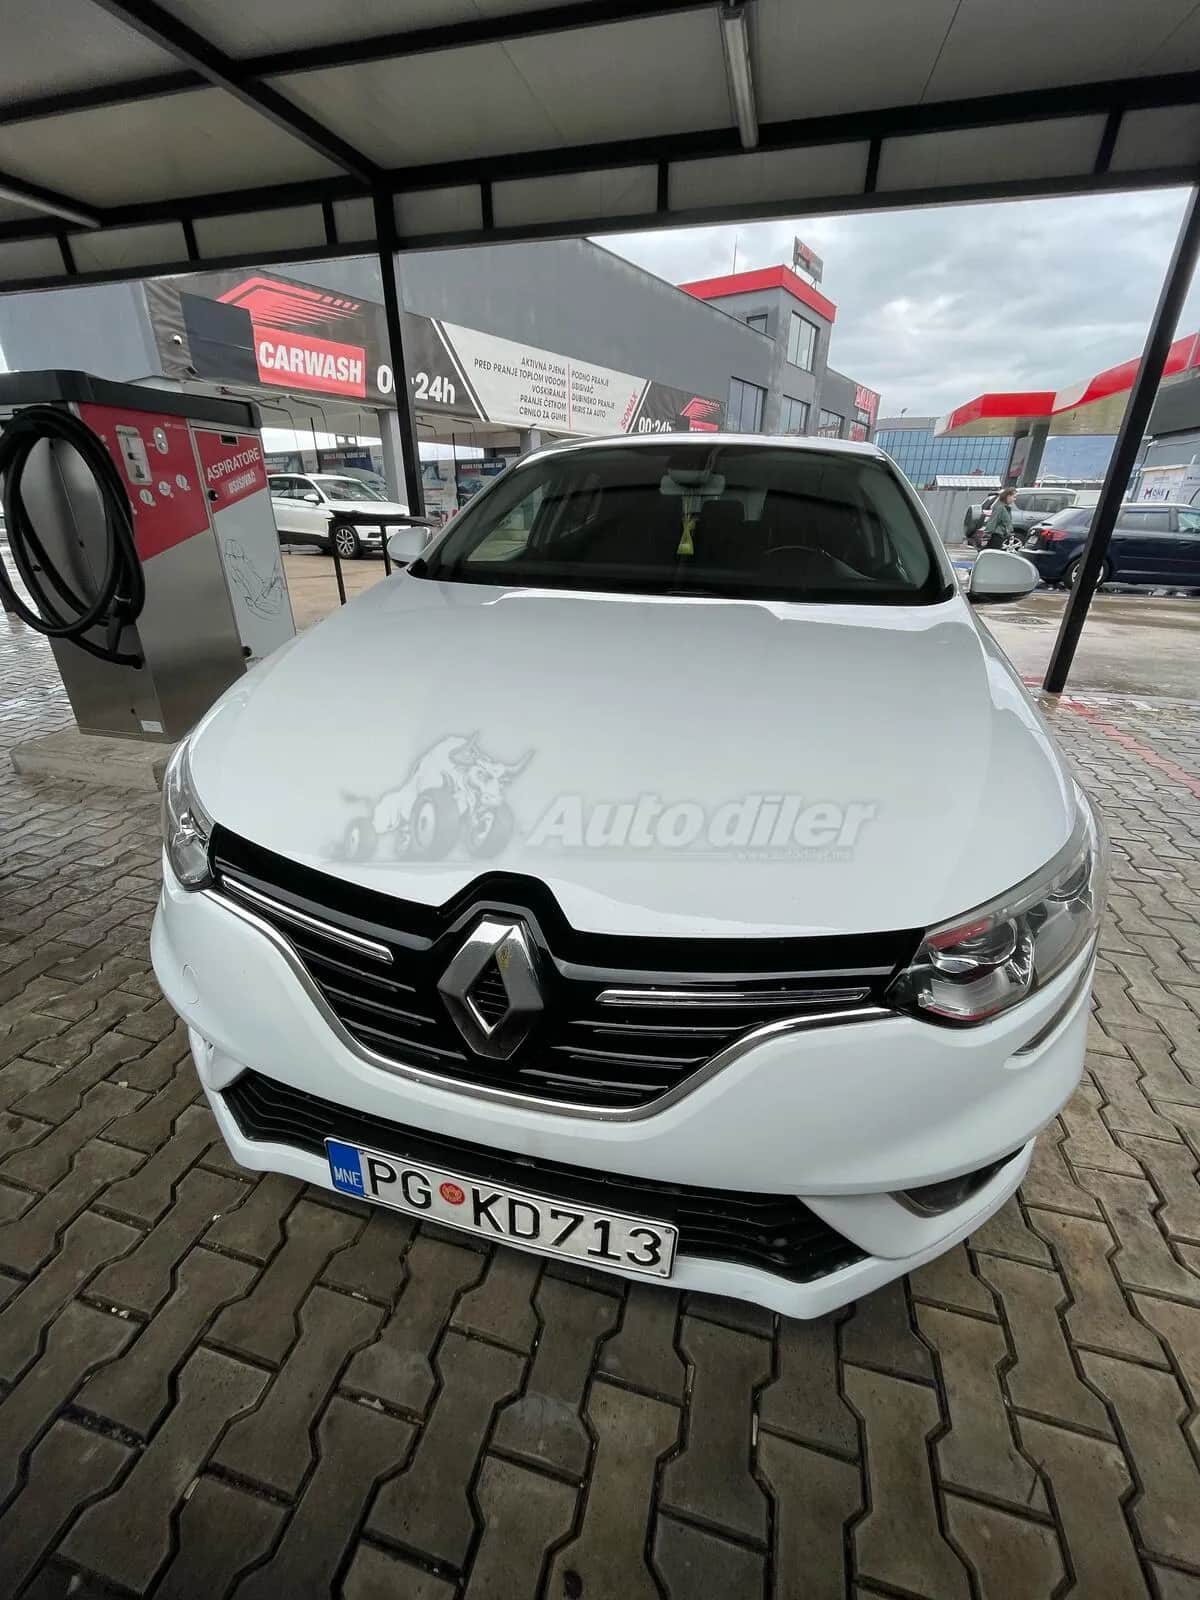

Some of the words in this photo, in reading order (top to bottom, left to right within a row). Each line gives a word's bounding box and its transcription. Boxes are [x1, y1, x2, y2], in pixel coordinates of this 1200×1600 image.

[259, 341, 362, 384] CARWASH
[521, 357, 547, 371] AKTIVNA
[549, 364, 566, 376] PJENA
[474, 358, 492, 370] PRED
[493, 363, 518, 376] PRANJE
[520, 369, 544, 382] TOPLOM
[545, 375, 566, 387] VODOM
[591, 375, 609, 386] PRANJE
[520, 394, 542, 406] PRANJE
[532, 385, 566, 399] VOSKIRANJE
[598, 399, 615, 409] PRANJE
[620, 391, 639, 430] SONAX
[519, 406, 541, 418] CRNILO
[542, 410, 550, 419] ZA
[550, 412, 567, 422] GUME
[207, 447, 261, 481] ASPIRATORE
[334, 1168, 361, 1188] MNE
[367, 1157, 432, 1210] PG
[471, 1187, 663, 1266] KD713
